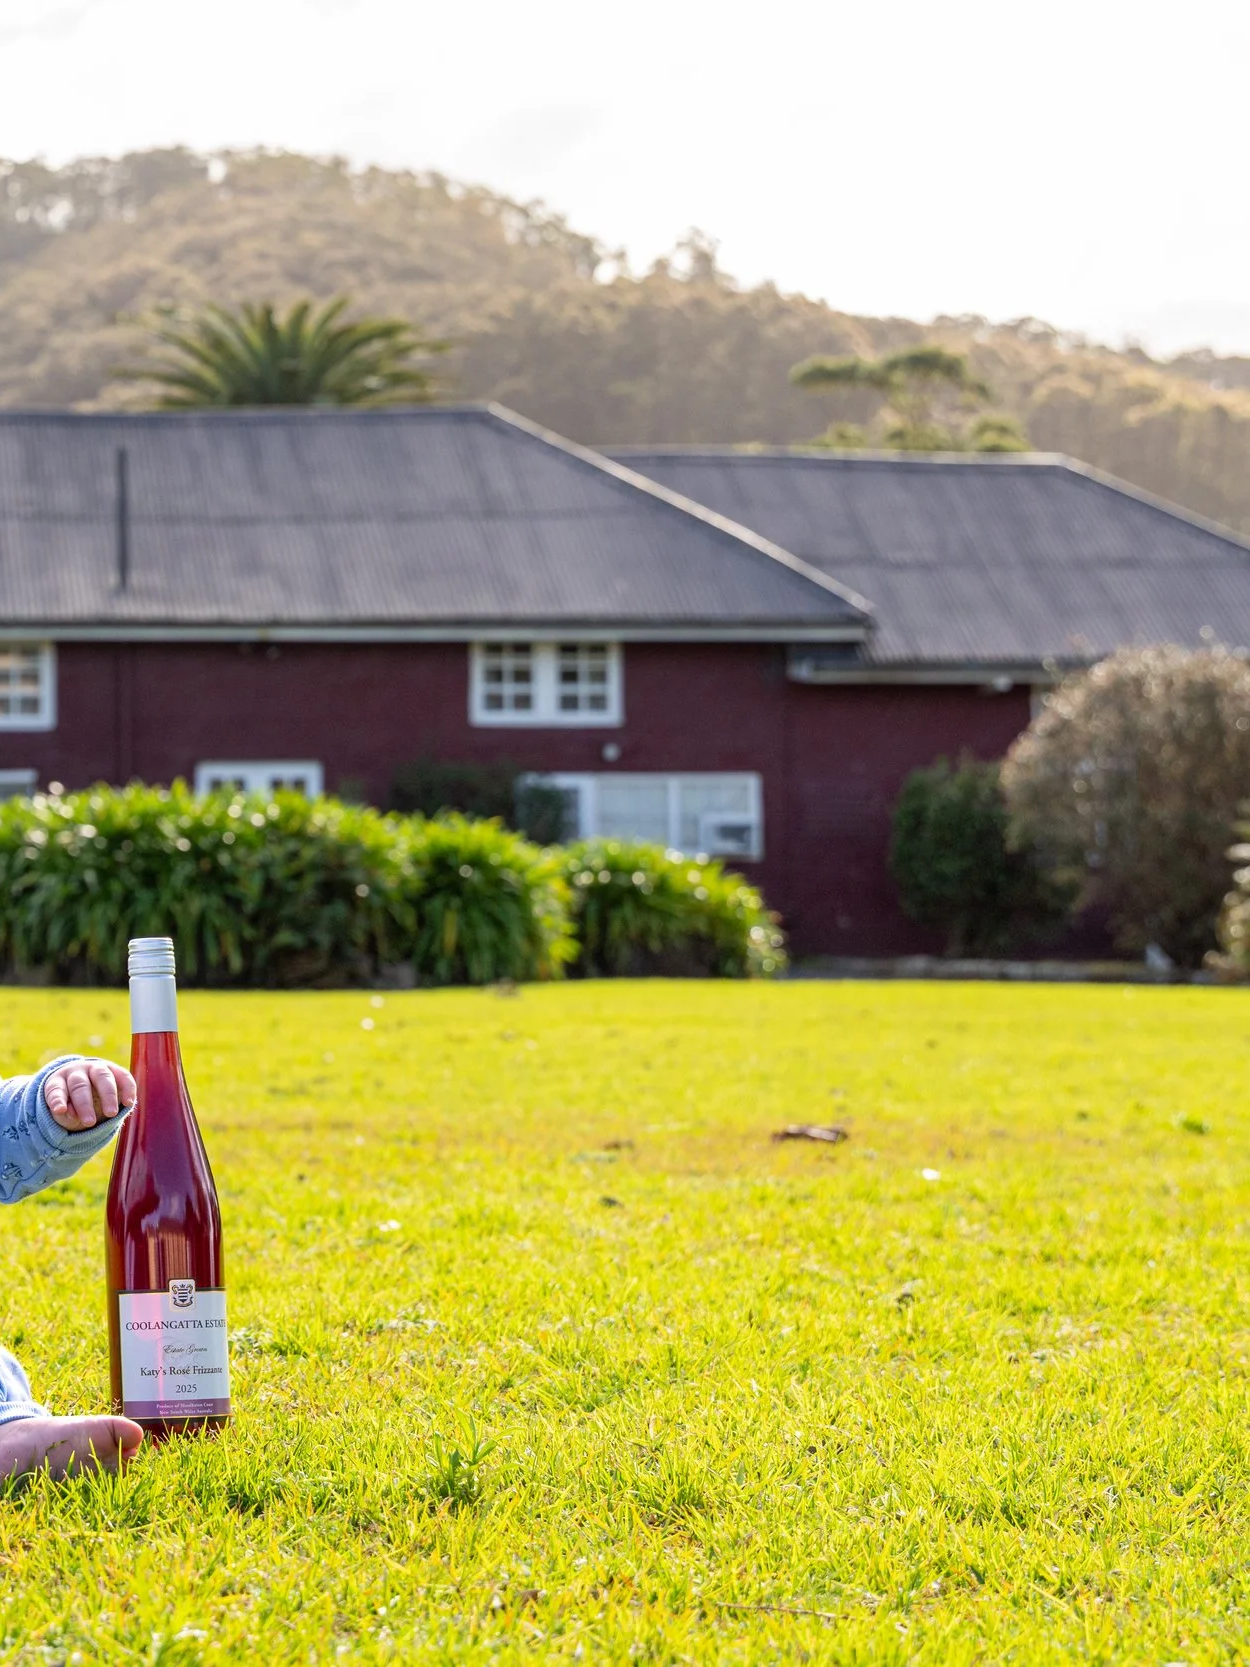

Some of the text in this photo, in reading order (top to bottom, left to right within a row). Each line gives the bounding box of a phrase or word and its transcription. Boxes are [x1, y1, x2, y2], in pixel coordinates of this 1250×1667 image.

[126, 1320, 204, 1330] COOLANGATTA
[140, 1365, 223, 1378] Katy's Rosé Frizzante
[175, 1384, 197, 1393] 2025
